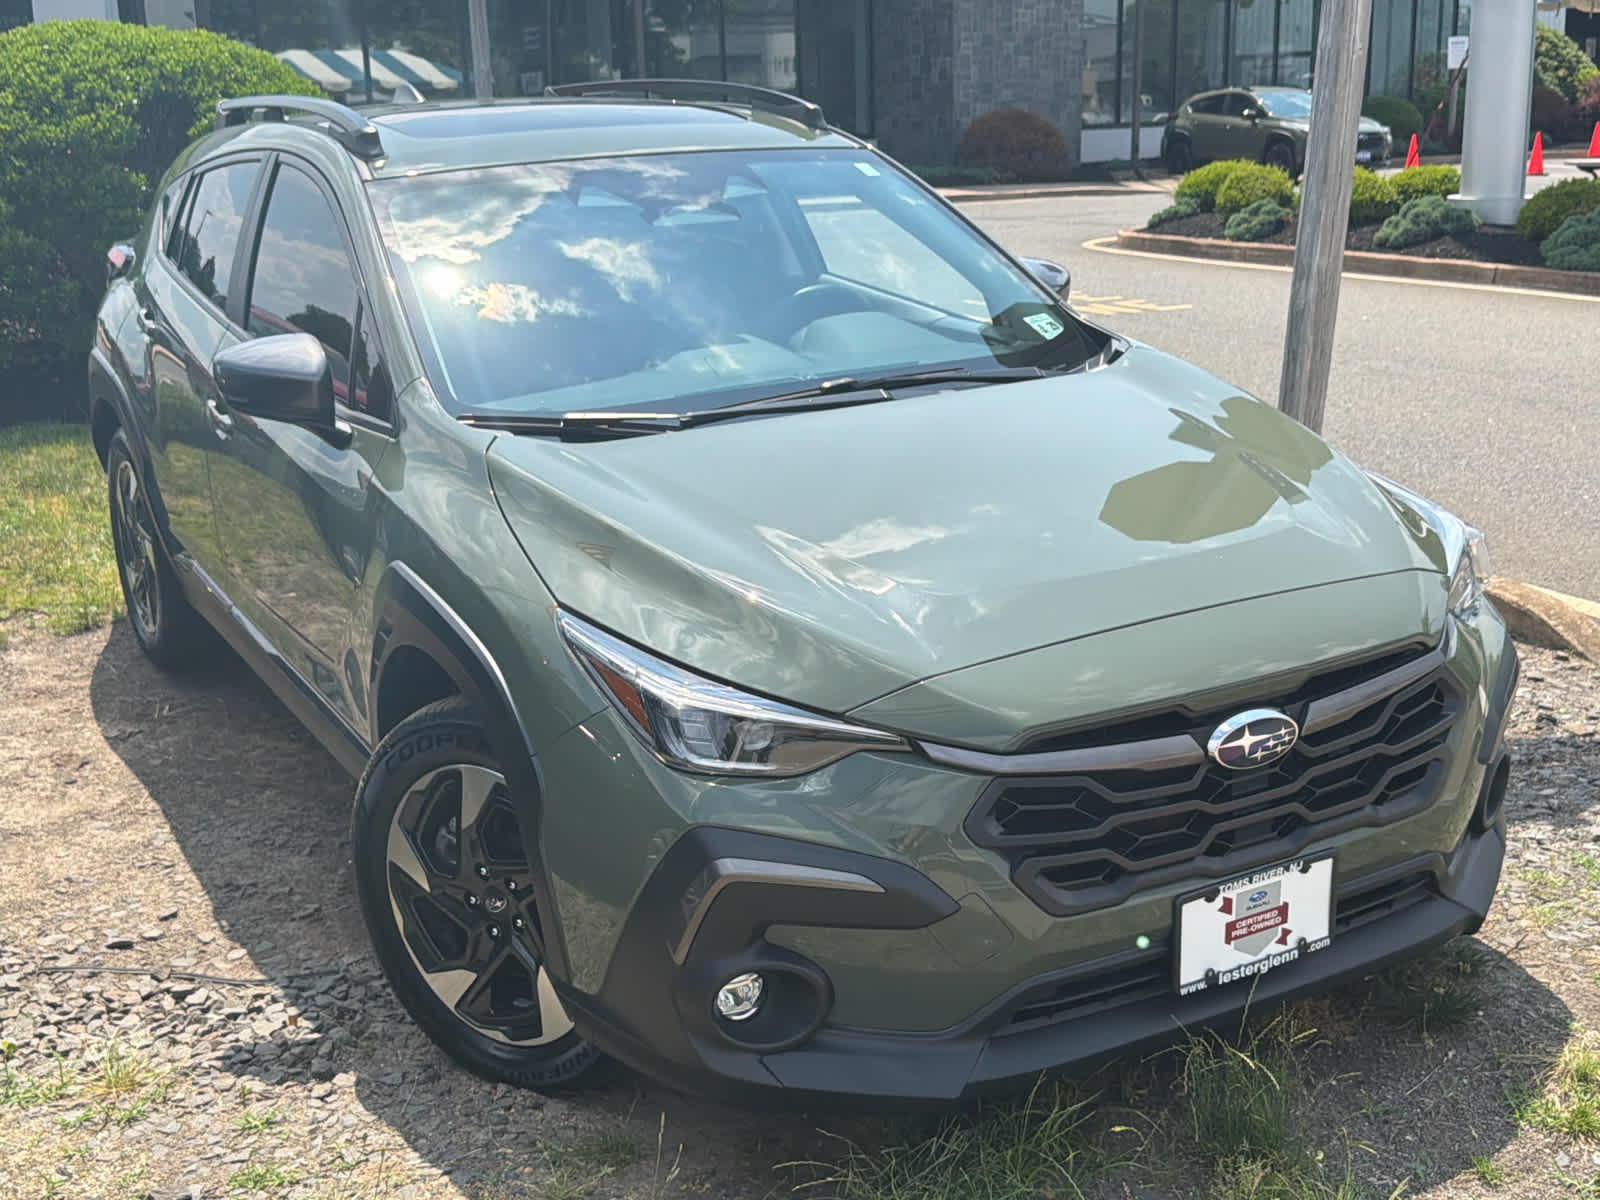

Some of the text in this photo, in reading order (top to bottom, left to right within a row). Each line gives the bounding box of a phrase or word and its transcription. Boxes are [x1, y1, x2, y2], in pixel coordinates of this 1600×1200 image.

[1218, 877, 1250, 893] TOMS
[1289, 860, 1304, 873] NJ
[1231, 915, 1282, 938] PRE-OWNED
[1235, 909, 1279, 929] CERTIFIED
[1218, 950, 1299, 985] lesterglenn
